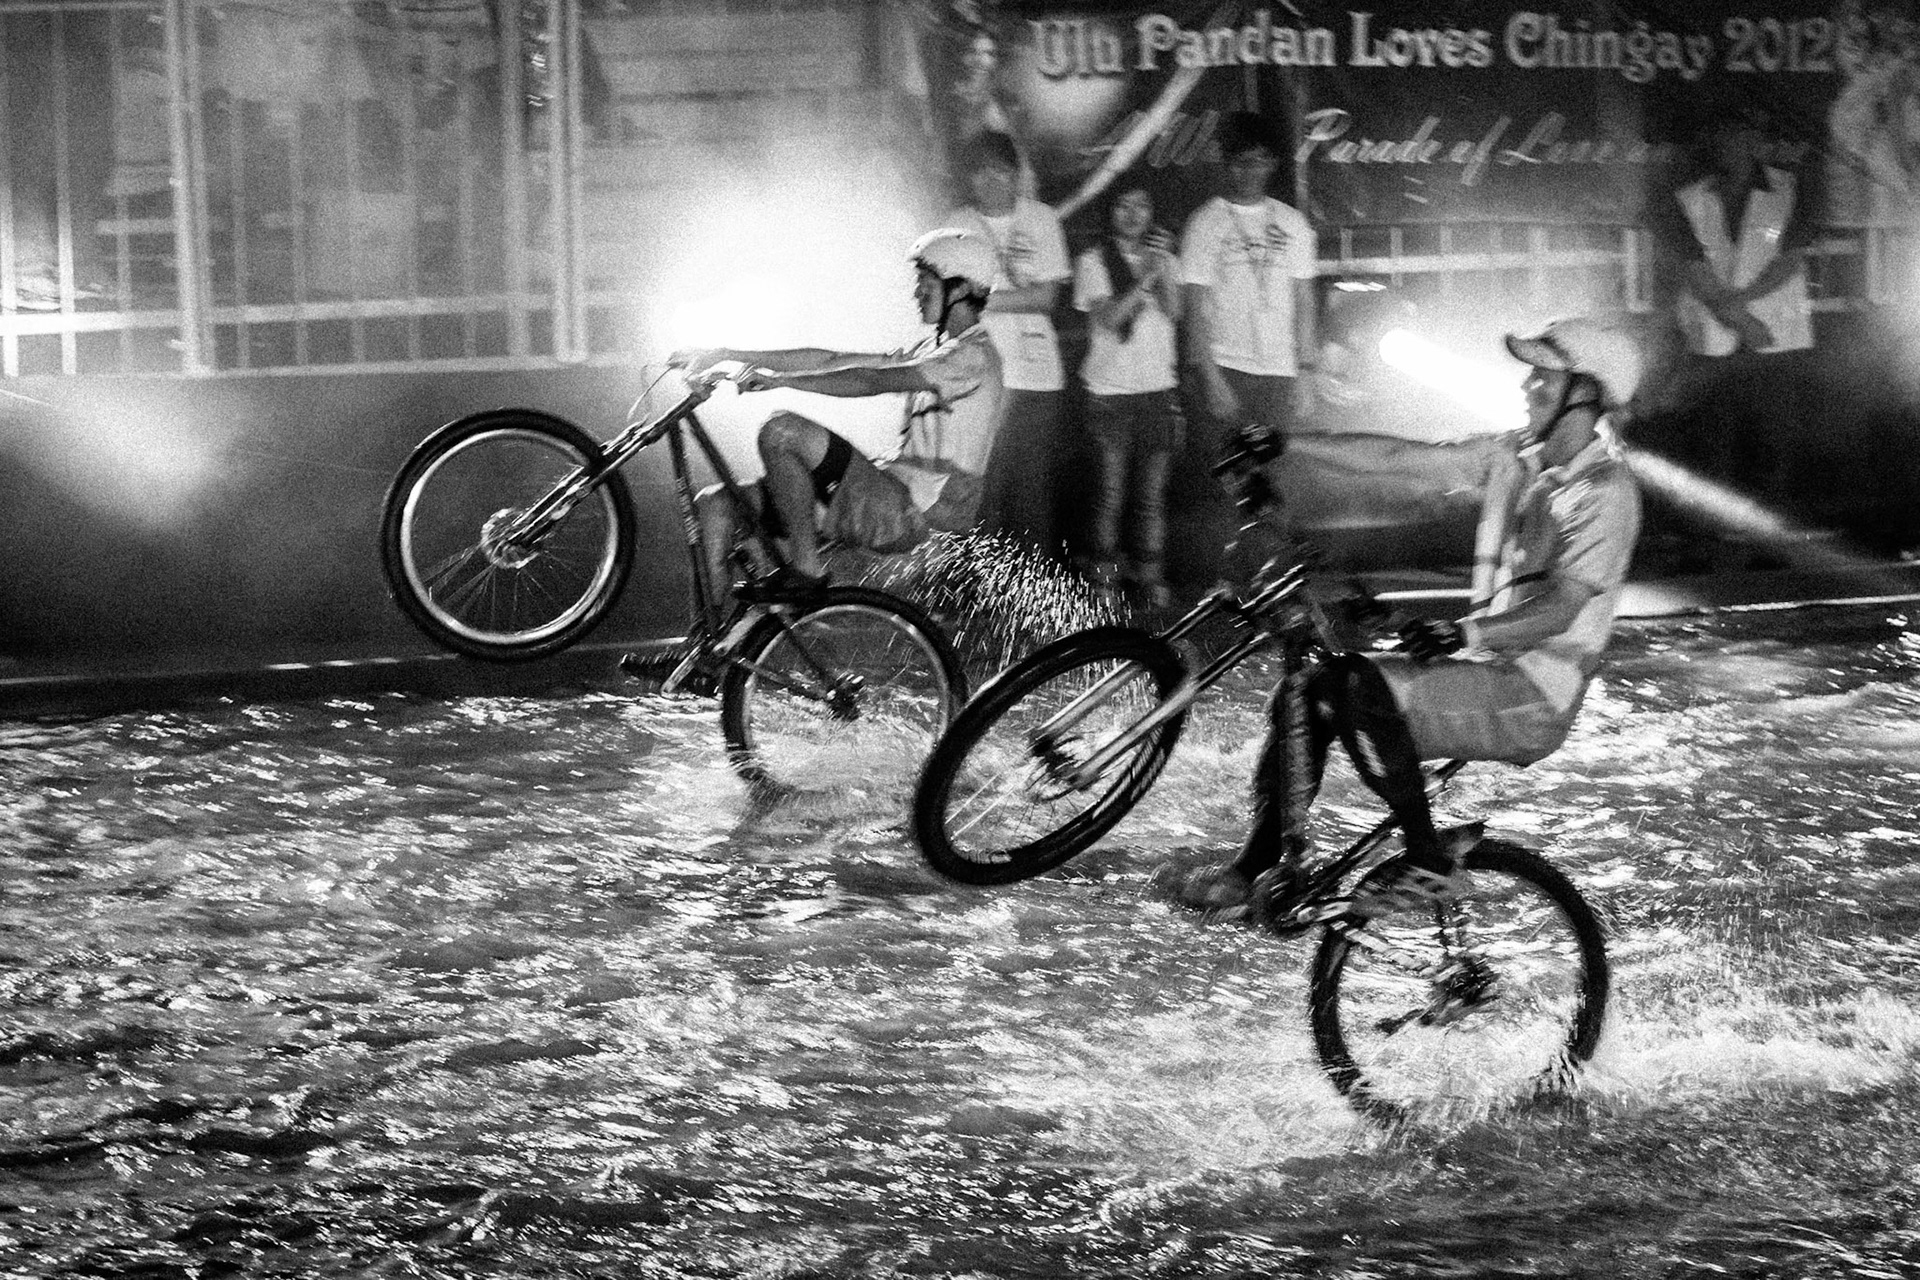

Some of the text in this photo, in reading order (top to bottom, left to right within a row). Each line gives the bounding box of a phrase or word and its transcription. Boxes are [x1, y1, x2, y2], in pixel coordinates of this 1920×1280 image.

[1133, 10, 1336, 71] Pandan
[1348, 11, 1494, 68] Loves
[1506, 12, 1712, 82] Chingay
[1724, 17, 1834, 72] 2012
